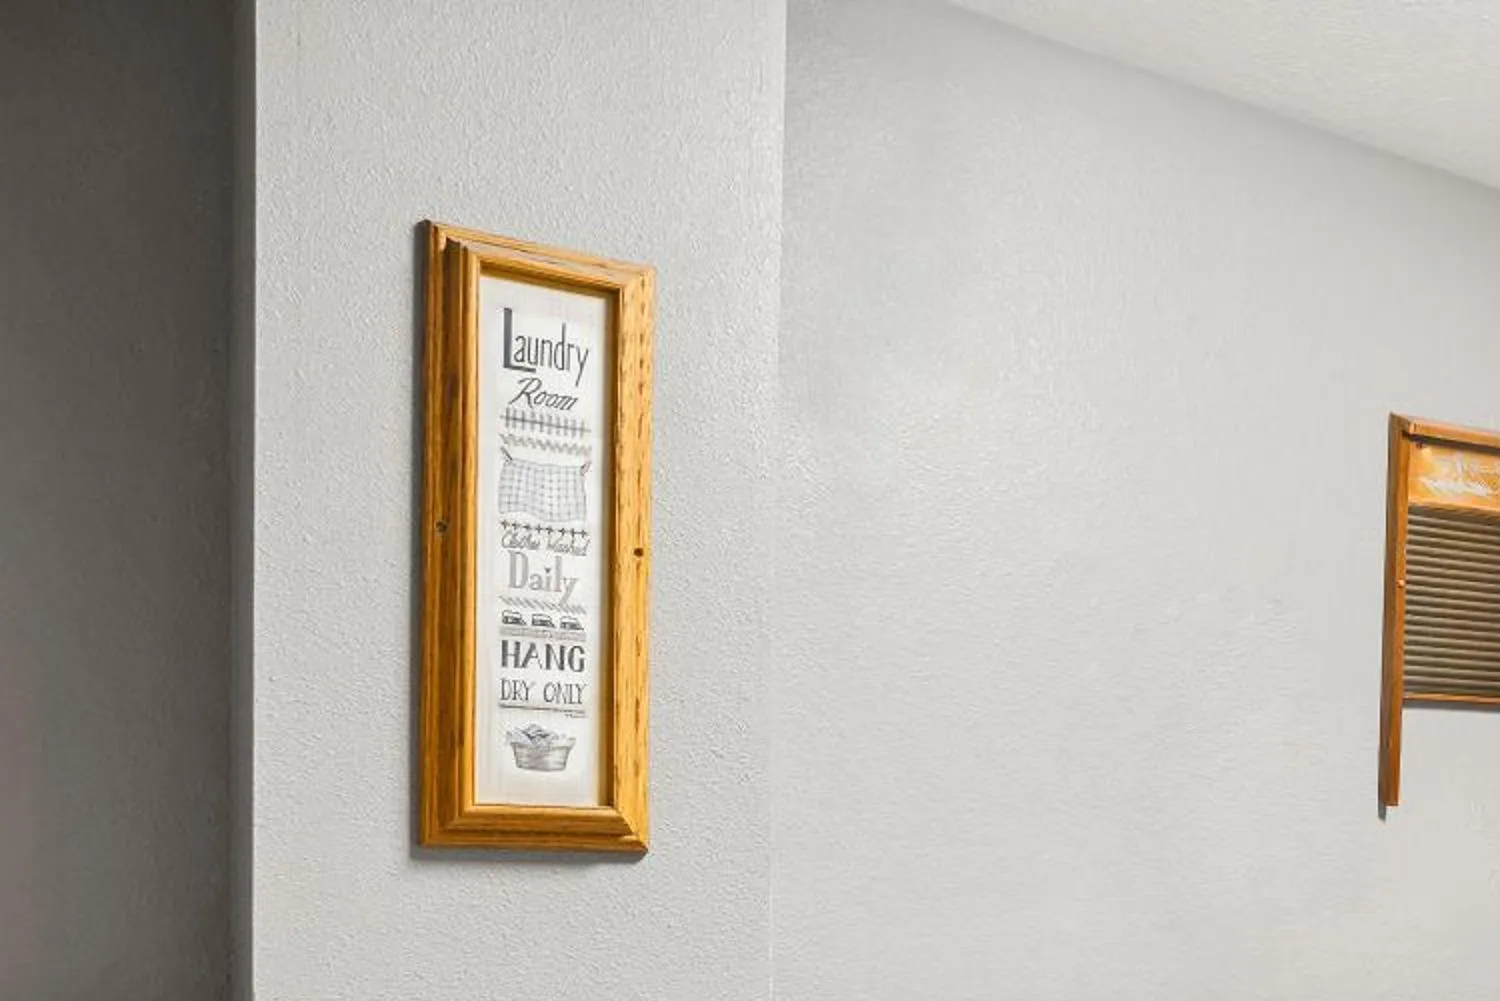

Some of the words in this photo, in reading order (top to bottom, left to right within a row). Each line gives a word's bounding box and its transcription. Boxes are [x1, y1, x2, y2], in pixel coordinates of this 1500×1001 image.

[503, 307, 589, 388] Laundry
[508, 377, 579, 411] Room
[507, 549, 580, 607] Daily
[501, 639, 586, 673] HANG
[500, 678, 537, 701] DRY
[543, 681, 588, 705] ONLY
